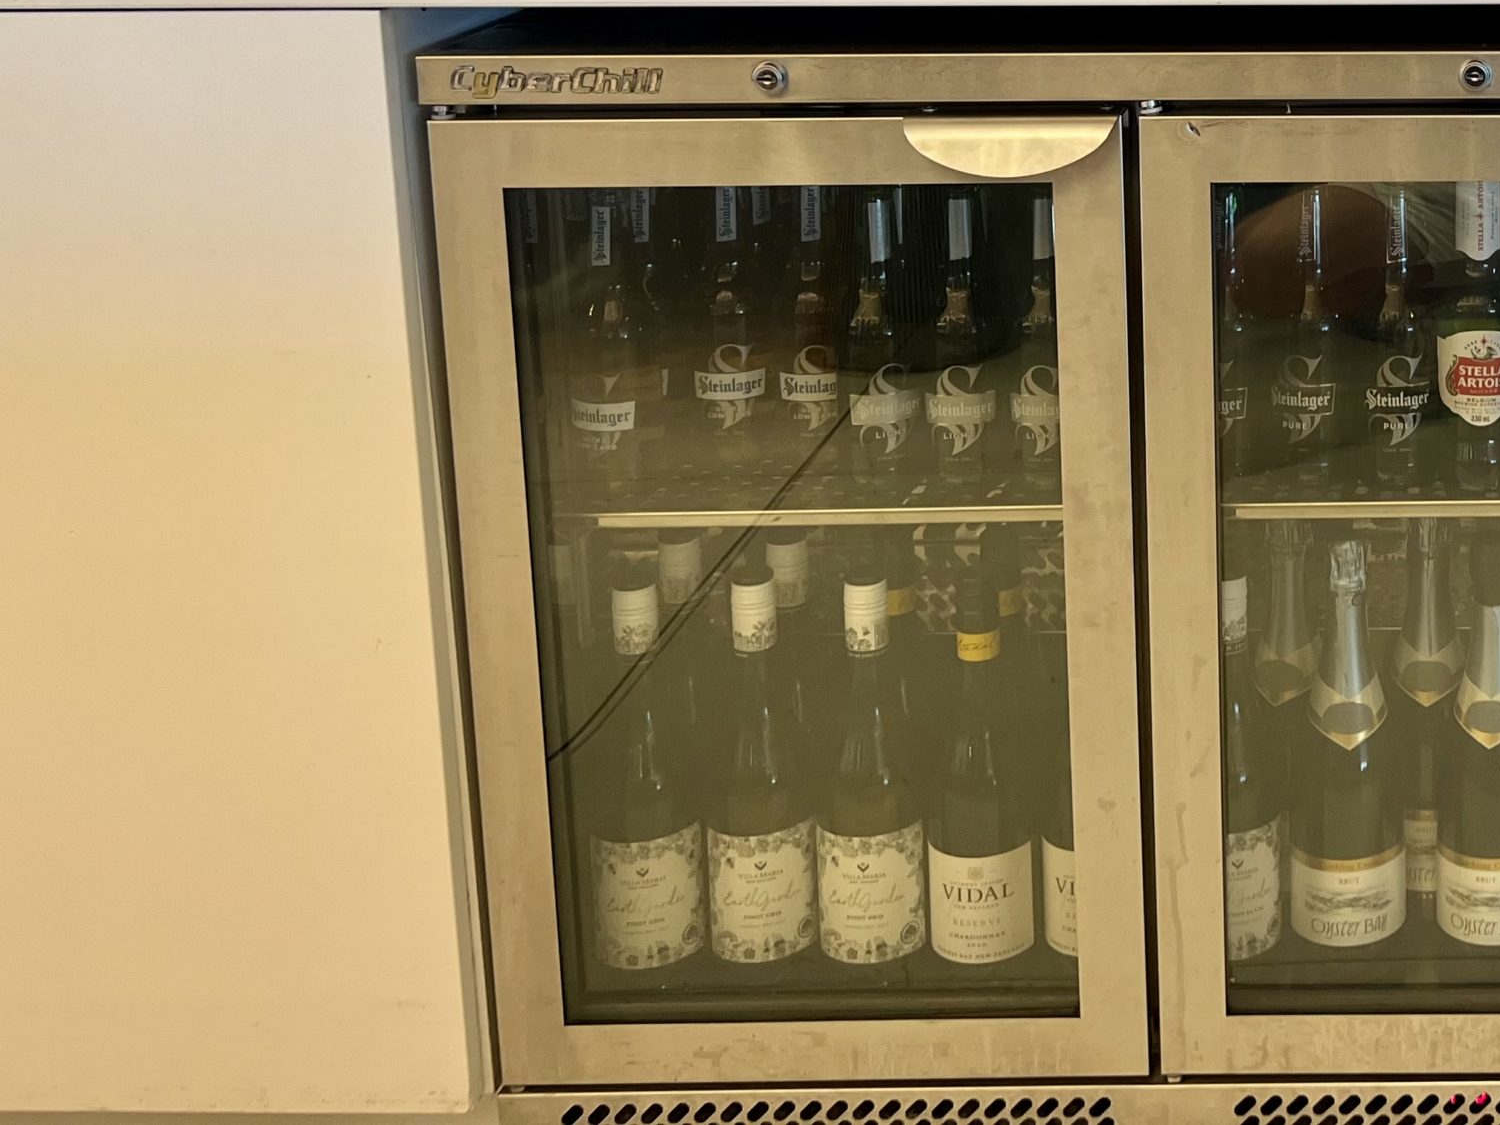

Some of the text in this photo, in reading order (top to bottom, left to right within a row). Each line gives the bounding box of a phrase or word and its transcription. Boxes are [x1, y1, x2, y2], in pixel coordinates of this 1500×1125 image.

[450, 65, 664, 99] CyberChill
[718, 187, 734, 238] Steinlager
[802, 187, 818, 238] Steinlager
[697, 373, 764, 398] Steinlager
[927, 398, 993, 420] Steinlager
[1364, 387, 1430, 410] Steinlager
[1470, 415, 1483, 423] 330
[1338, 877, 1360, 885] BRUT
[1475, 875, 1497, 884] BRUT
[942, 881, 1015, 903] VIDAL
[1310, 917, 1361, 940] Oyster
[1450, 913, 1498, 936] Oyster
